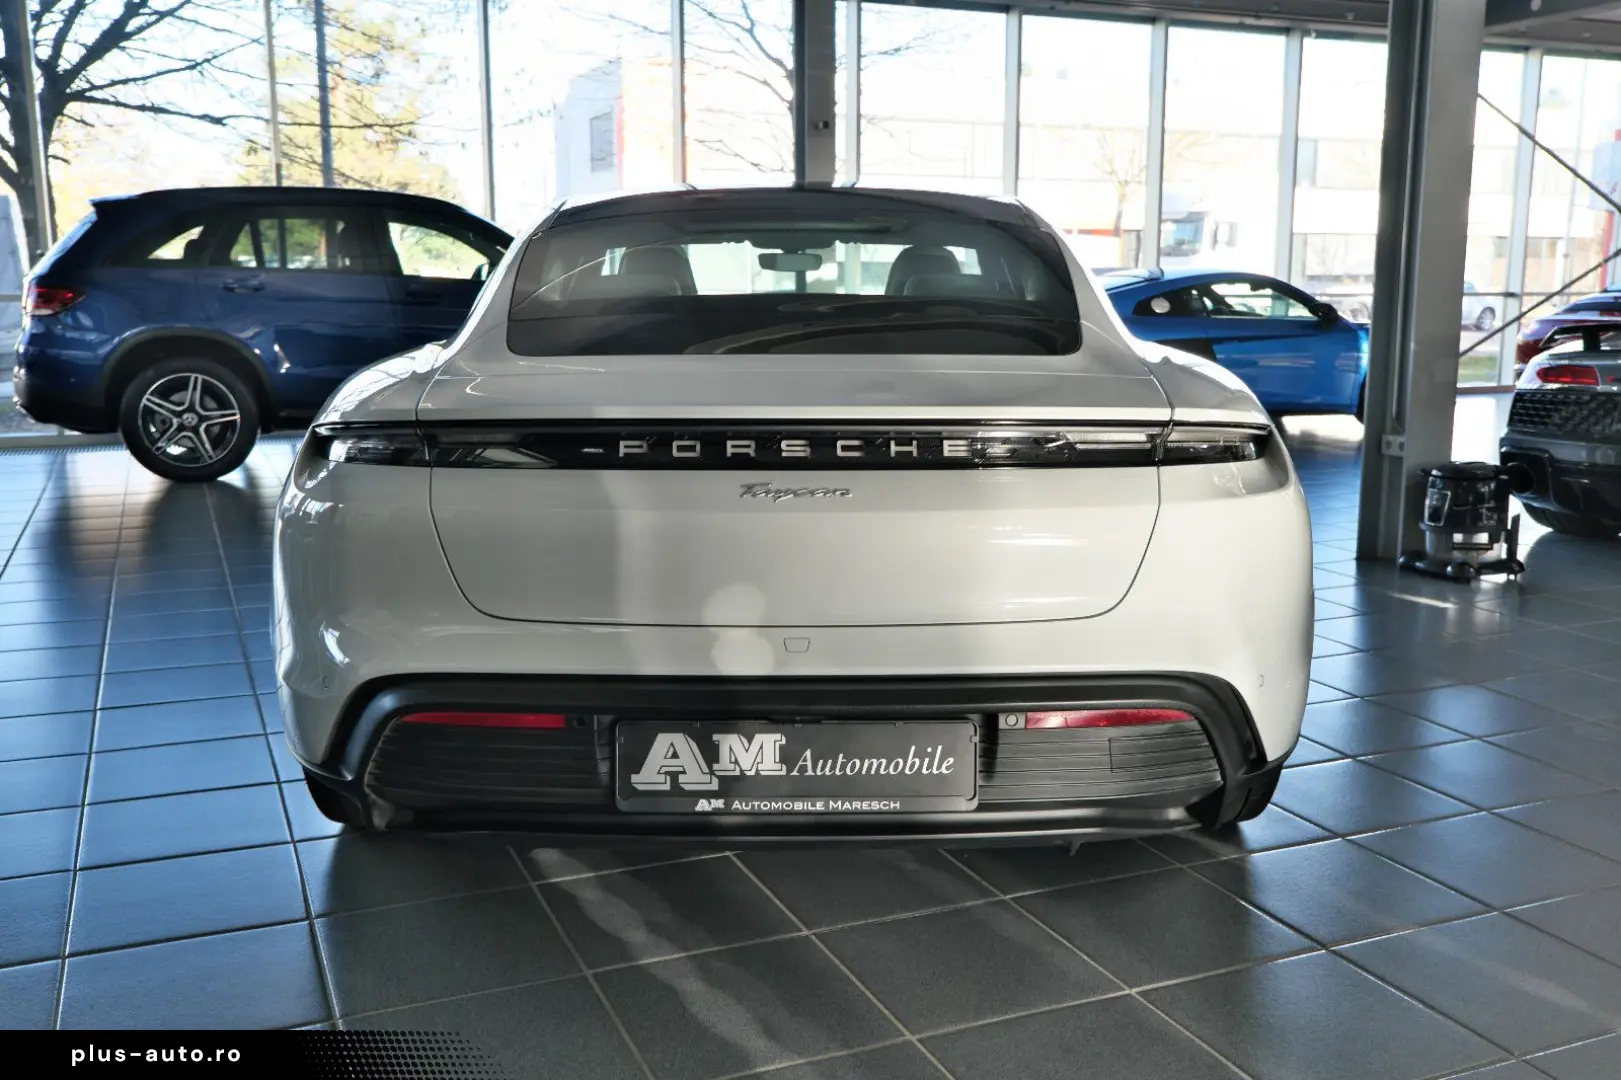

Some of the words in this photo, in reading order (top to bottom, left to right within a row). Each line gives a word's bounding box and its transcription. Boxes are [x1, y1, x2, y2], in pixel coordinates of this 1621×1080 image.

[618, 440, 972, 457] PORSCHE
[739, 482, 853, 503] Taycan
[630, 732, 787, 791] AM
[790, 745, 955, 776] Automobile
[731, 799, 825, 811] AUTOMOBILE
[829, 799, 900, 811] MARESCH
